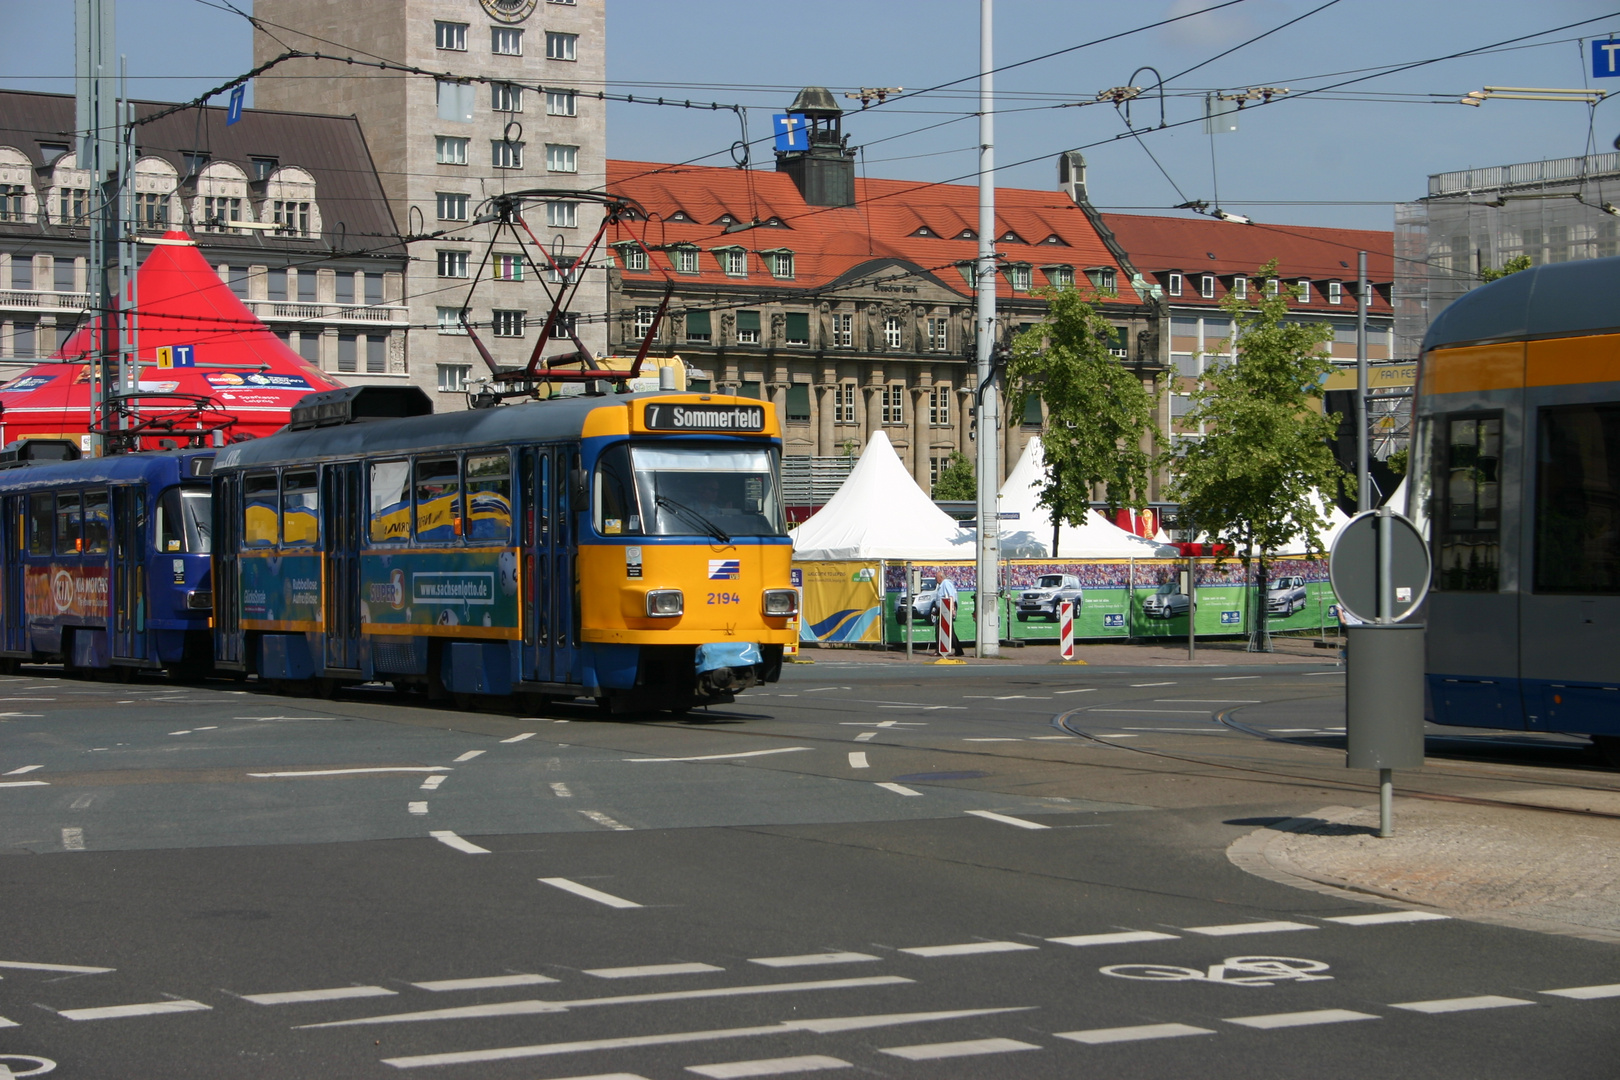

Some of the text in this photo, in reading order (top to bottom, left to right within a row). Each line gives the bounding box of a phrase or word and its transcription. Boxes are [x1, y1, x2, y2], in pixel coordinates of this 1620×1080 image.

[1601, 44, 1620, 72] T
[780, 118, 798, 146] T
[873, 284, 918, 294] Dresdner Bank
[162, 347, 189, 366] 1 T
[1380, 370, 1399, 379] FAN
[650, 406, 761, 429] 7 Sommerfeld
[194, 460, 203, 476] 7
[56, 580, 70, 601] KIA
[75, 577, 108, 593] KIA MOTORS
[370, 570, 405, 609] SUPER 6
[420, 579, 488, 597] www.sachsenlotto.de
[707, 592, 740, 604] 2194
